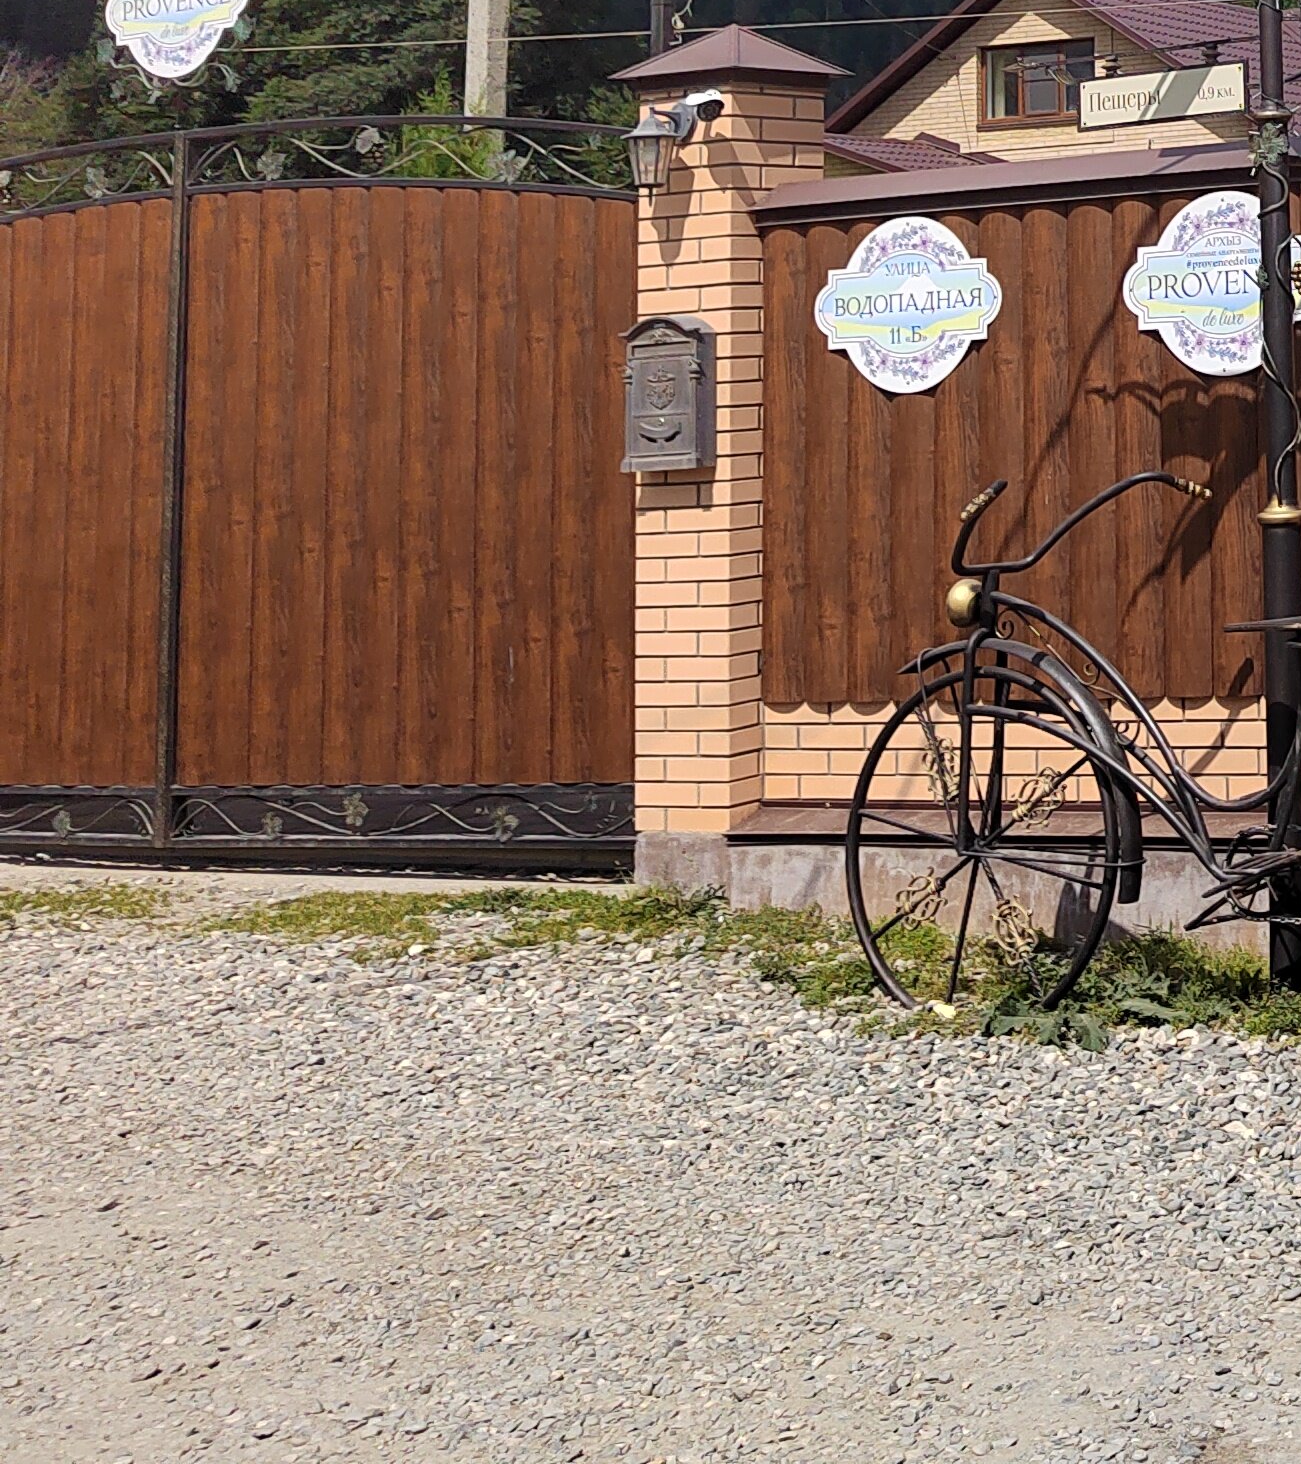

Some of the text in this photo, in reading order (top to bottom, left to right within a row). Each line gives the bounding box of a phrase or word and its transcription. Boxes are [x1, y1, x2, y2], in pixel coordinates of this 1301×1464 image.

[1089, 90, 1161, 113] Пещеры
[1204, 235, 1242, 247] АРХЫЗ
[885, 261, 931, 277] УЛИЦА
[834, 287, 983, 319] ВОДОПАДНАЯ
[889, 327, 901, 345] 11
